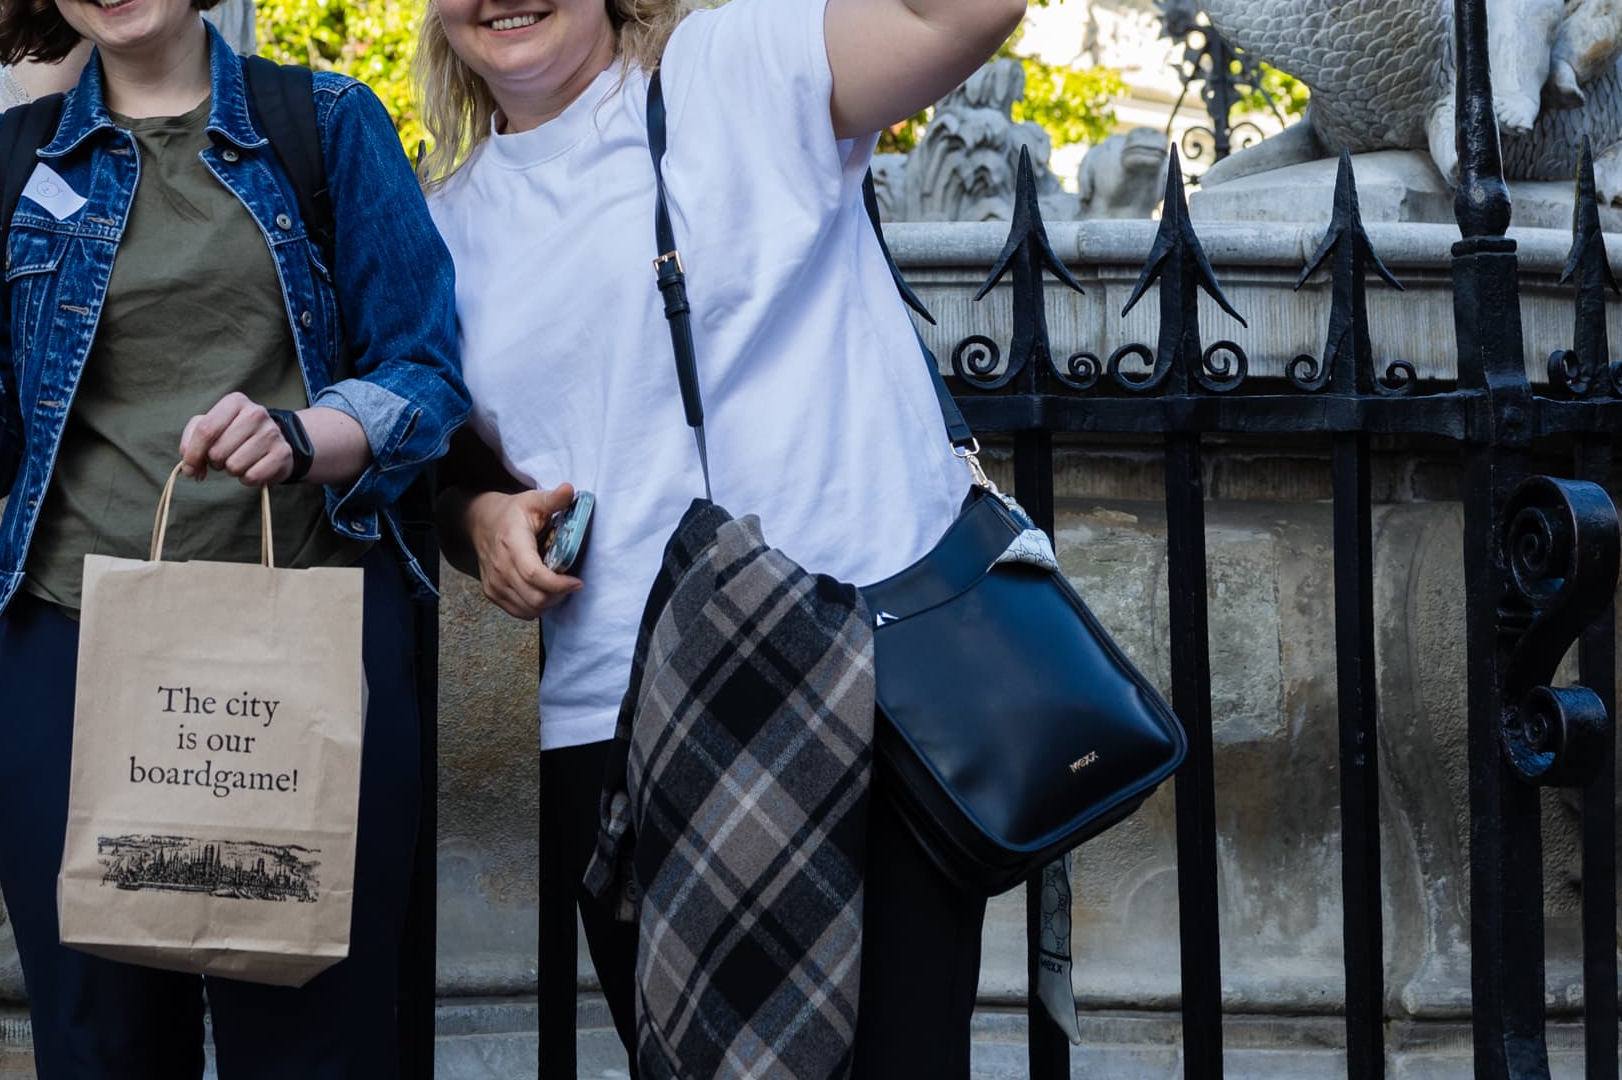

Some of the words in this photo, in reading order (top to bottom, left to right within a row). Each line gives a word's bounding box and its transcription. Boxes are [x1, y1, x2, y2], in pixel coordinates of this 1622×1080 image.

[158, 686, 216, 714] The
[226, 691, 280, 727] city
[177, 724, 197, 750] is
[207, 732, 256, 754] our
[129, 756, 298, 798] boardgame!
